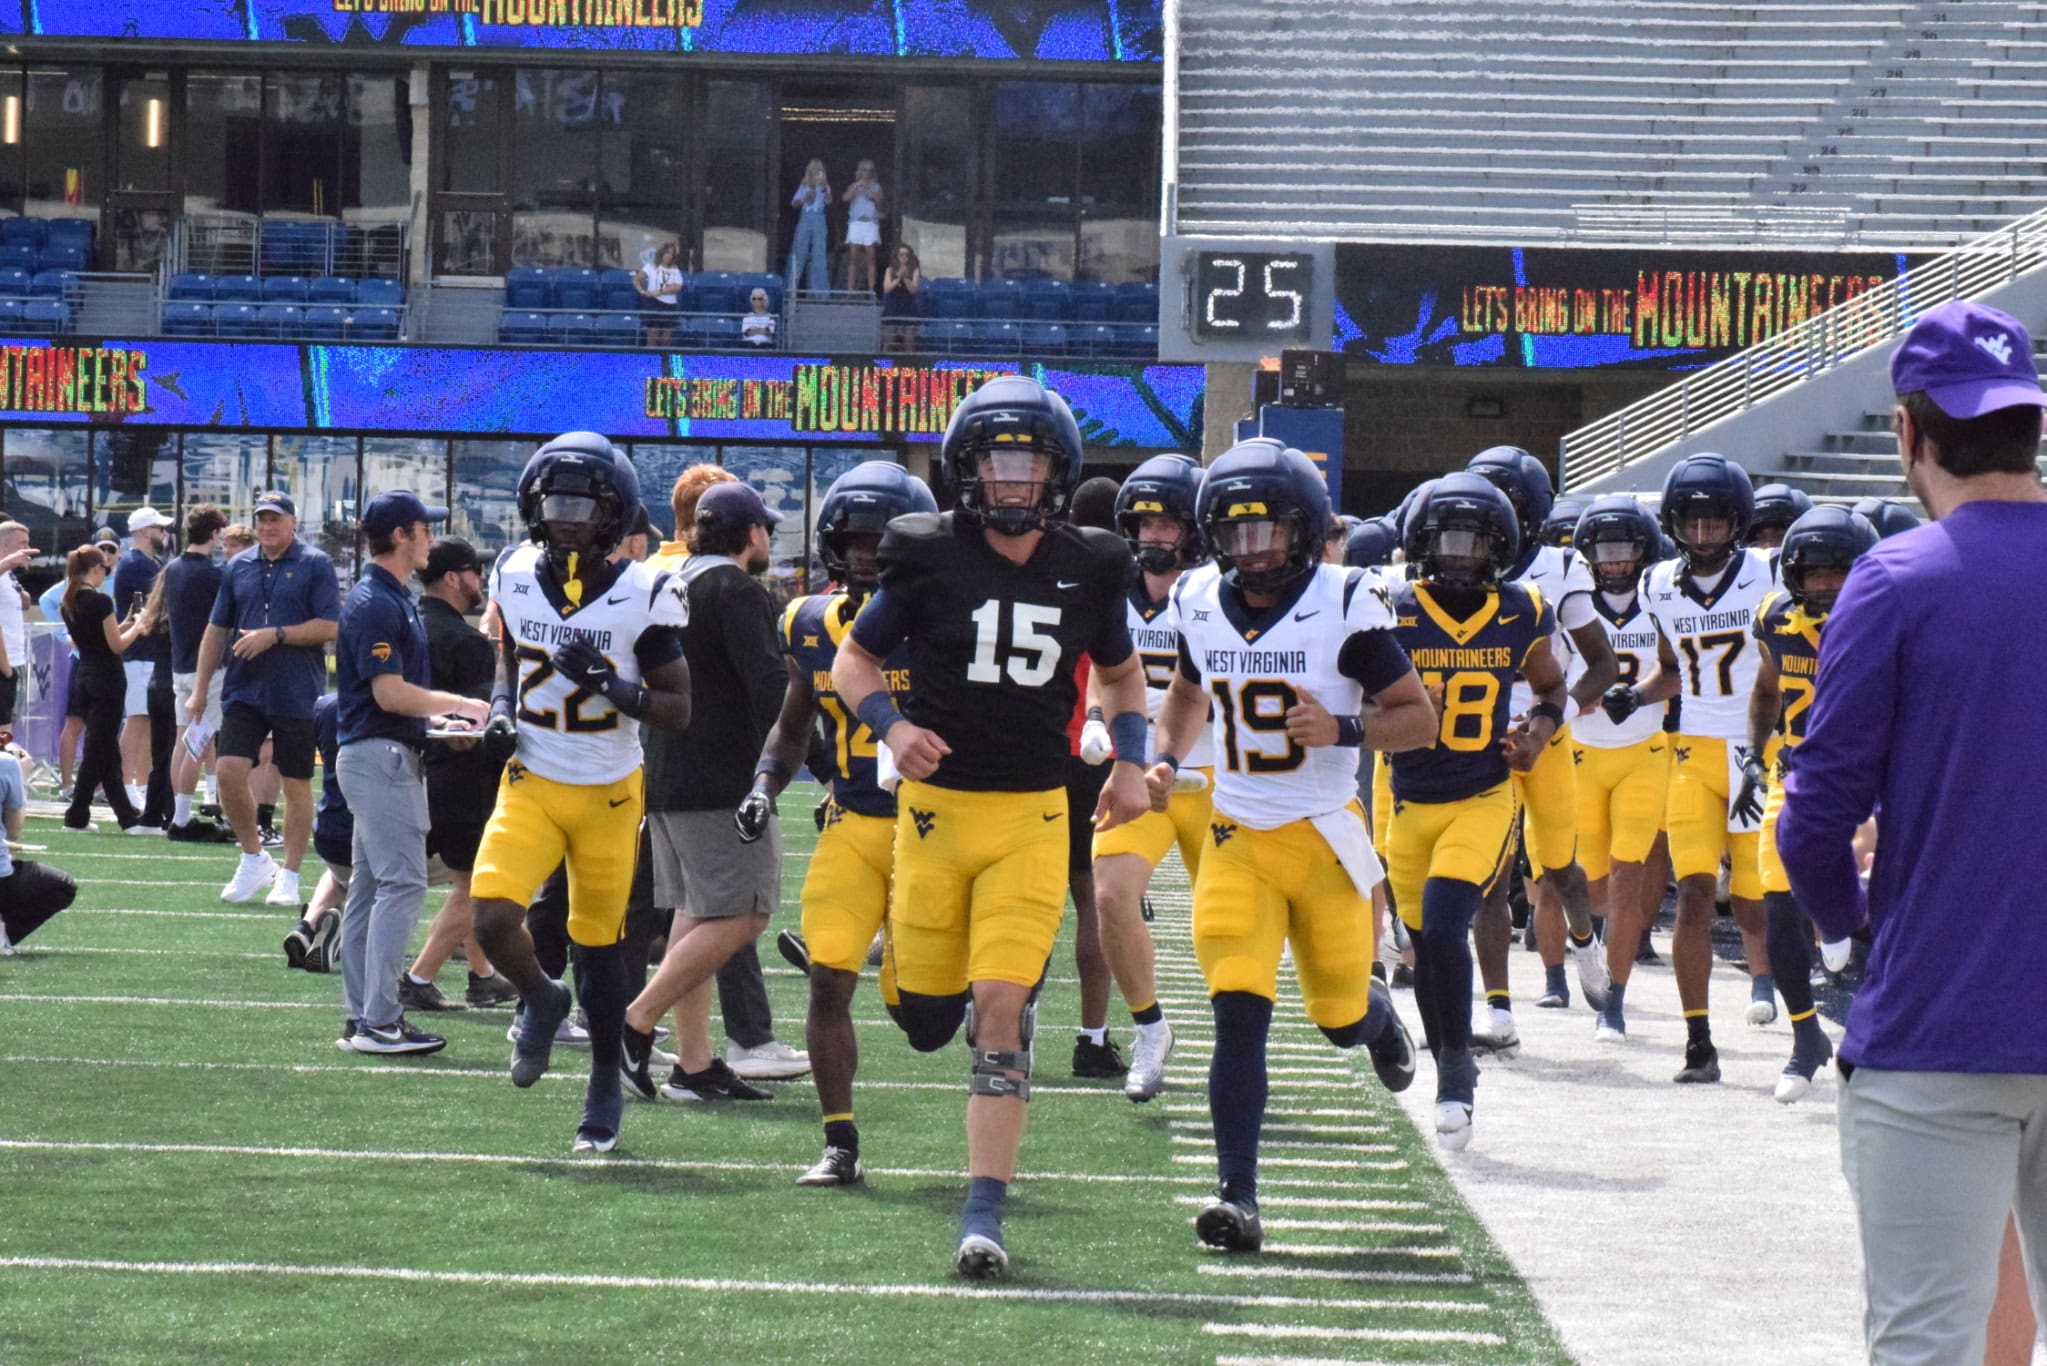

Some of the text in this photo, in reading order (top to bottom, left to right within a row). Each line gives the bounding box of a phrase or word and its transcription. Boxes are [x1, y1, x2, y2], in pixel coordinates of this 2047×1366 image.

[1206, 258, 1302, 329] 25
[1515, 287, 1569, 333] BRING
[1574, 287, 1597, 333] ON
[1602, 288, 1632, 334] THE
[765, 379, 793, 419] THE
[520, 618, 548, 643] WEST
[1137, 629, 1177, 649] VIRGIN
[1611, 632, 1656, 649] VIRGINIA
[1673, 616, 1698, 635] WEST
[1700, 608, 1750, 632] VIRGINIA
[967, 598, 1062, 687] 15
[1205, 649, 1236, 673] WEST
[1239, 650, 1307, 674] VIRGINIA
[1411, 646, 1511, 669] MOUNTAINEERS
[1679, 629, 1746, 697] 17
[514, 641, 620, 734] 22
[1211, 677, 1307, 776] 19
